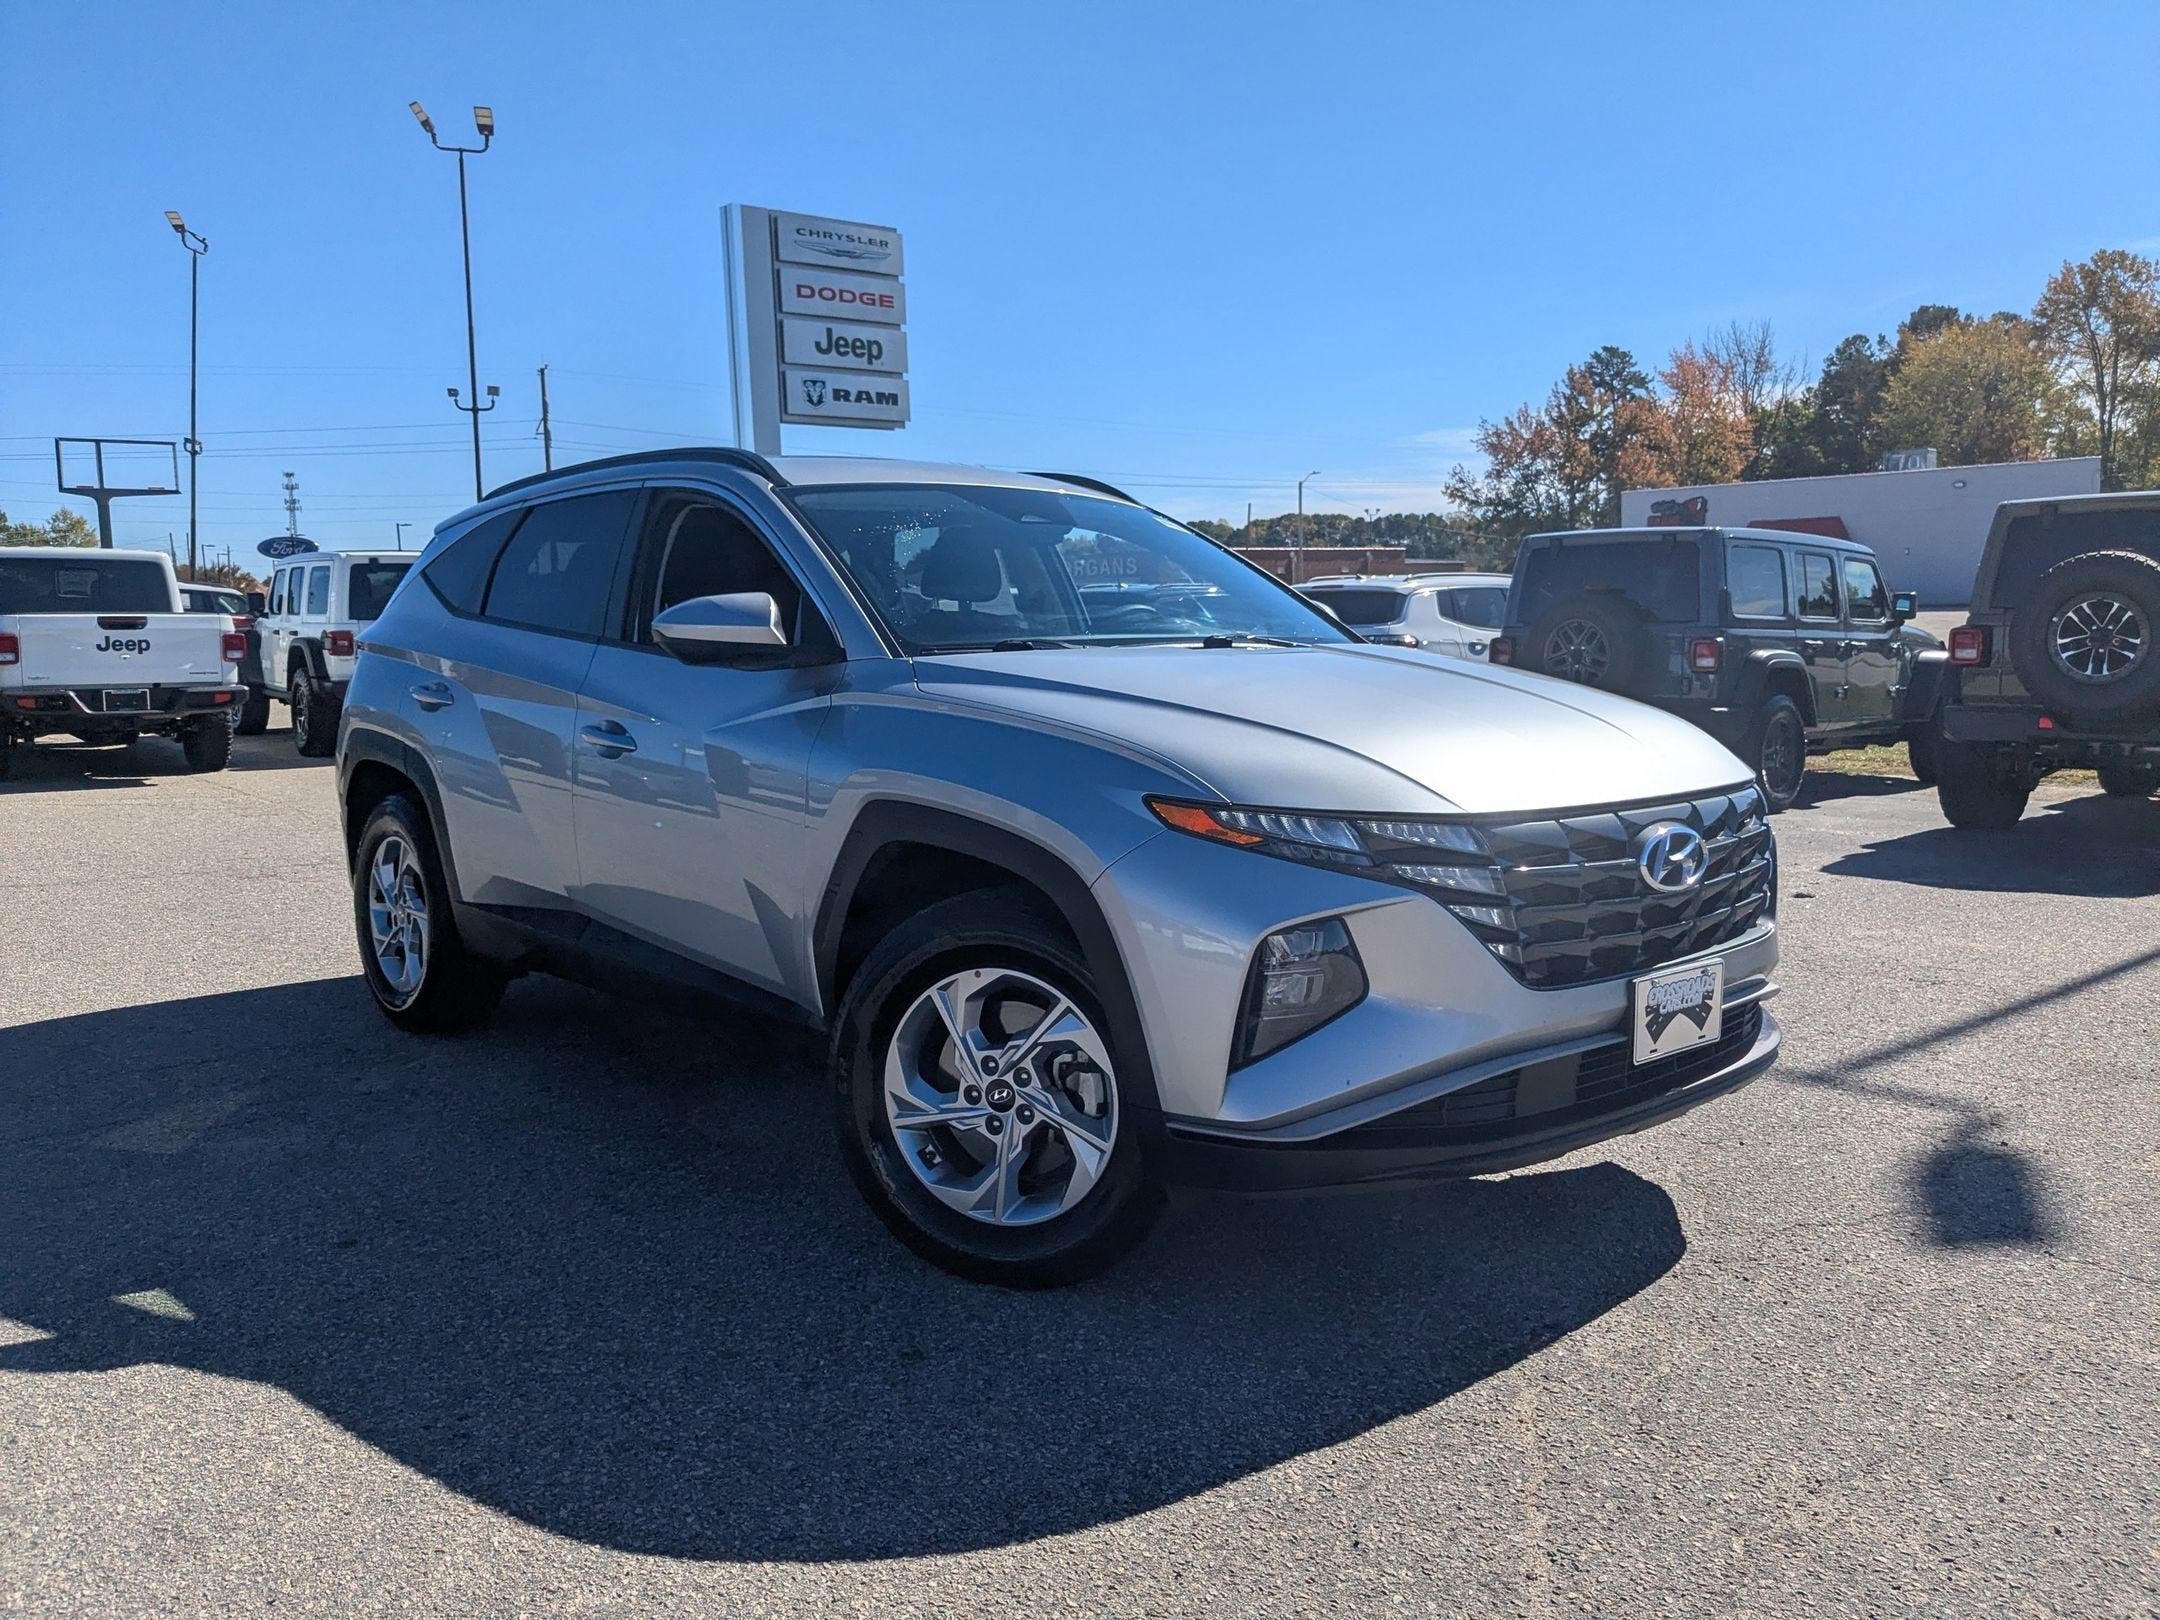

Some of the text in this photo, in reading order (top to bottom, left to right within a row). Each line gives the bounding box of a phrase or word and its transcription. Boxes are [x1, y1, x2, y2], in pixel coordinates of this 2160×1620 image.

[796, 227, 889, 249] CHRYSLER
[796, 284, 895, 309] DODGE
[815, 327, 883, 365] Jeep
[832, 388, 899, 406] RAM
[270, 541, 306, 555] Ford
[96, 636, 150, 655] Jeep
[1647, 973, 1716, 1007] CROSSROADS
